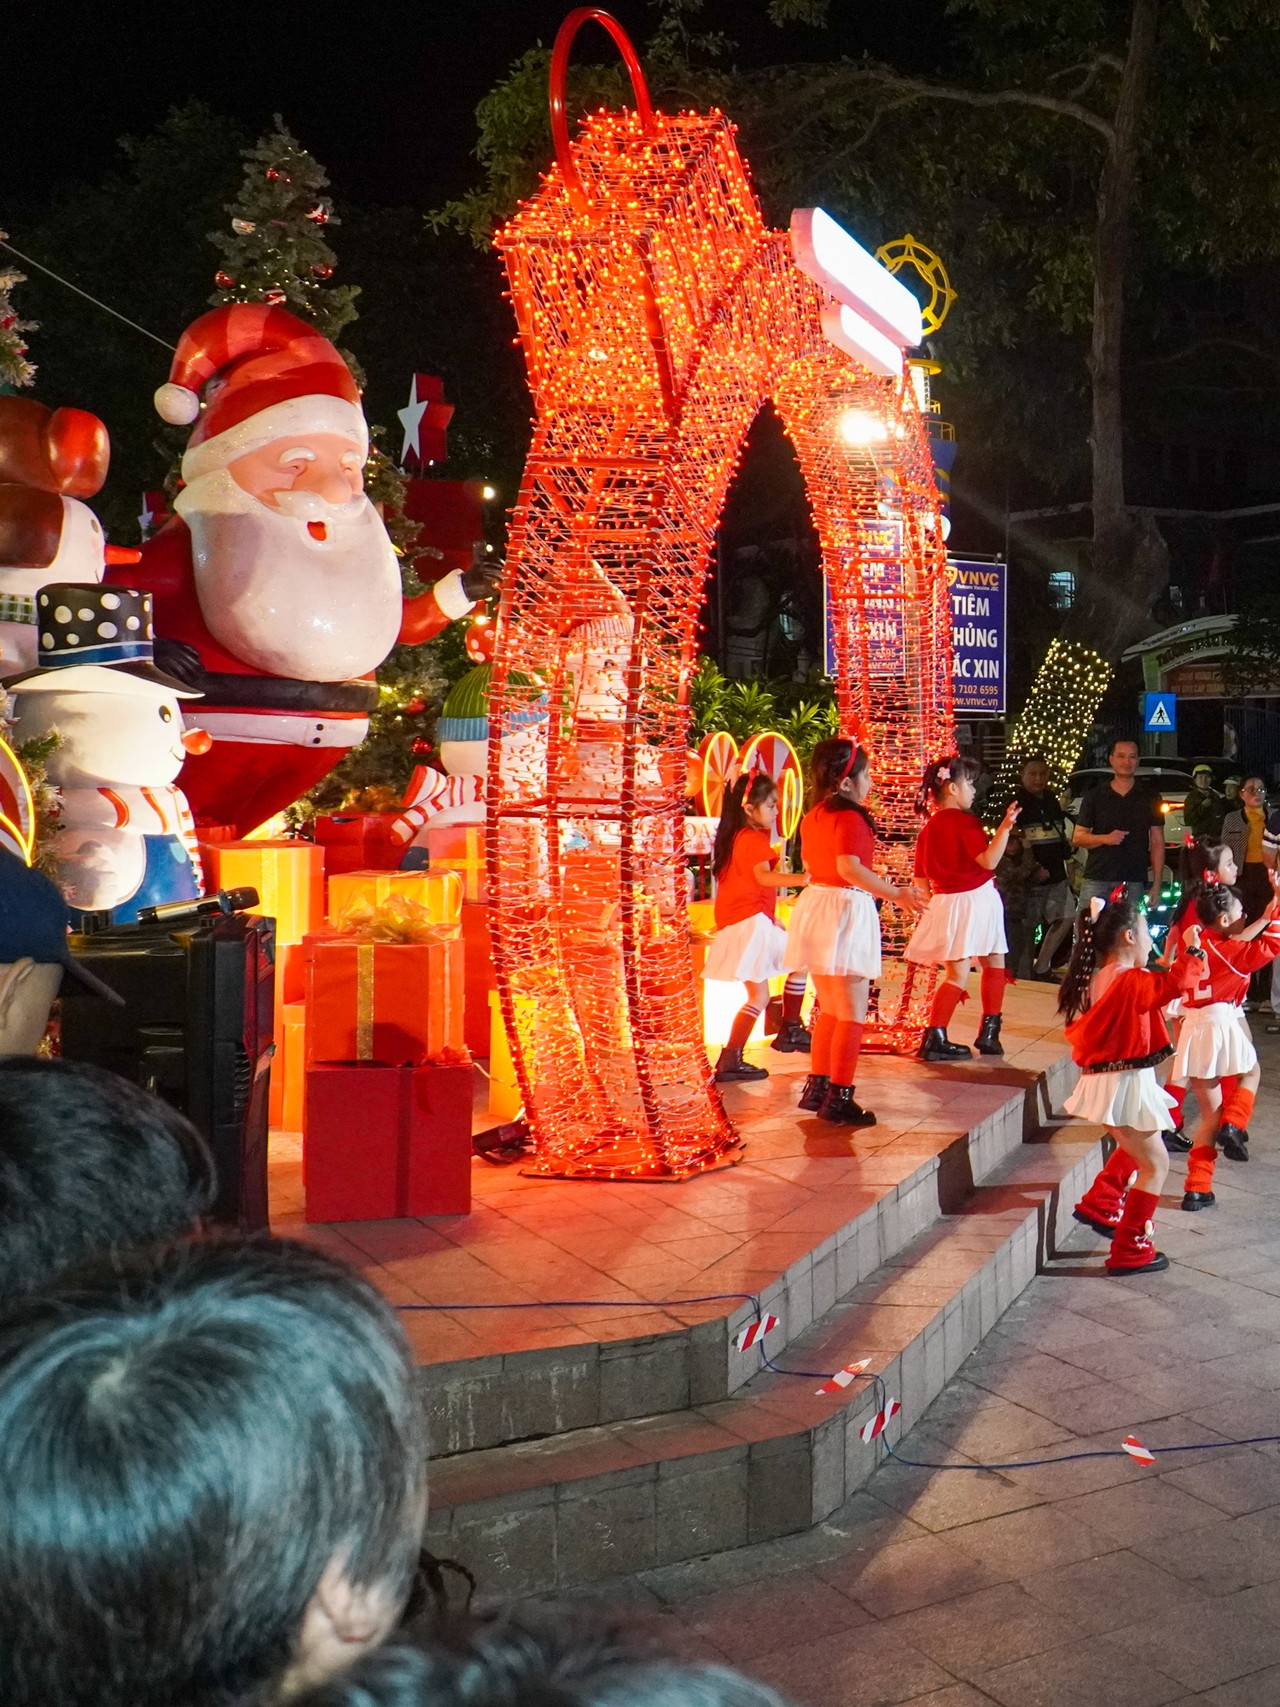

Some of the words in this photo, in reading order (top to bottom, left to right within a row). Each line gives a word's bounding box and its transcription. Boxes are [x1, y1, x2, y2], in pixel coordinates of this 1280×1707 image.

[958, 569, 999, 587] VNVC
[952, 593, 990, 617] TIÊM
[950, 622, 998, 648] HỦNG
[973, 659, 1000, 679] XIN
[959, 684, 978, 694] 7102
[979, 685, 998, 695] 6595
